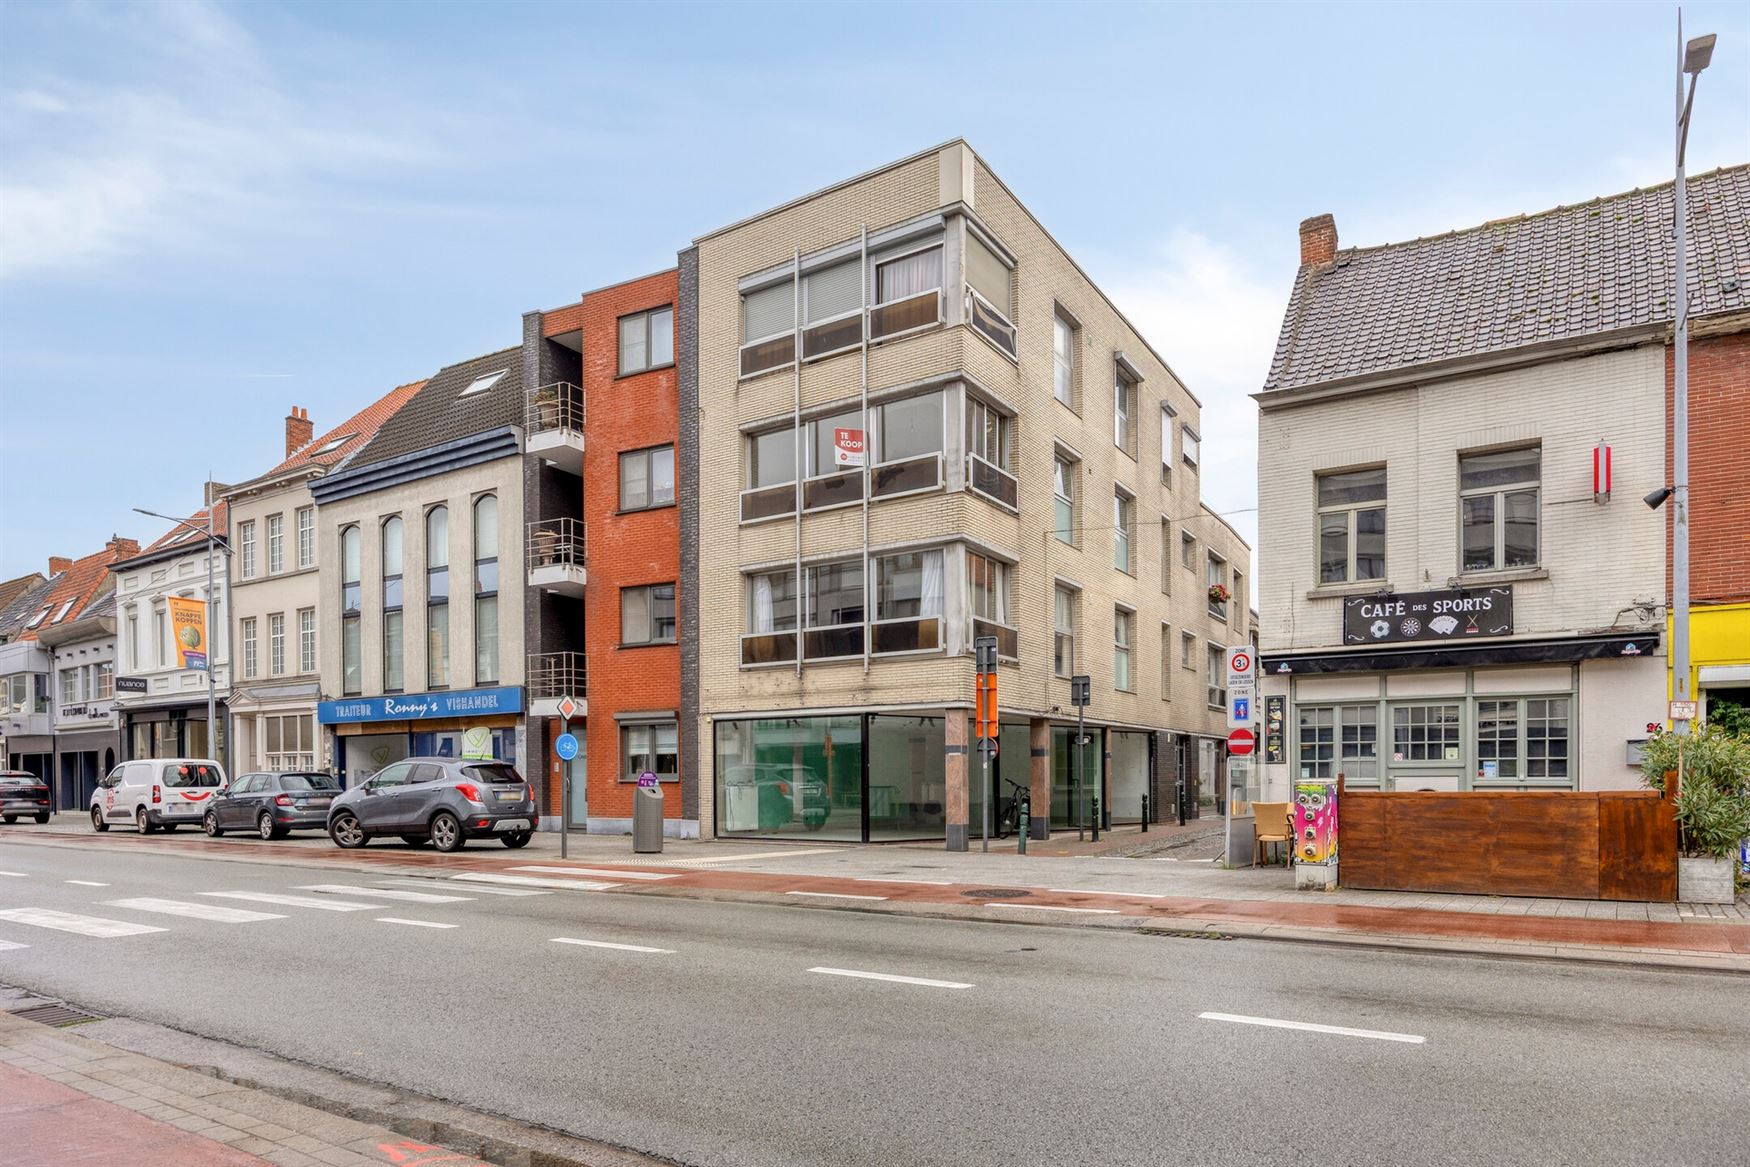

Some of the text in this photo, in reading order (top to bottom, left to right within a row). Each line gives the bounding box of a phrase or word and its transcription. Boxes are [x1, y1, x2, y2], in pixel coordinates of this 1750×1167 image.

[840, 432, 849, 440] TE
[840, 440, 863, 449] KOOP
[1360, 597, 1493, 618] CAFÉ DES SPORTS
[175, 611, 202, 620] KNAPPE
[175, 616, 203, 625] KOPPEN
[118, 680, 145, 688] nuance
[335, 695, 499, 718] TRAITEUR Ronny's VISHANDEL
